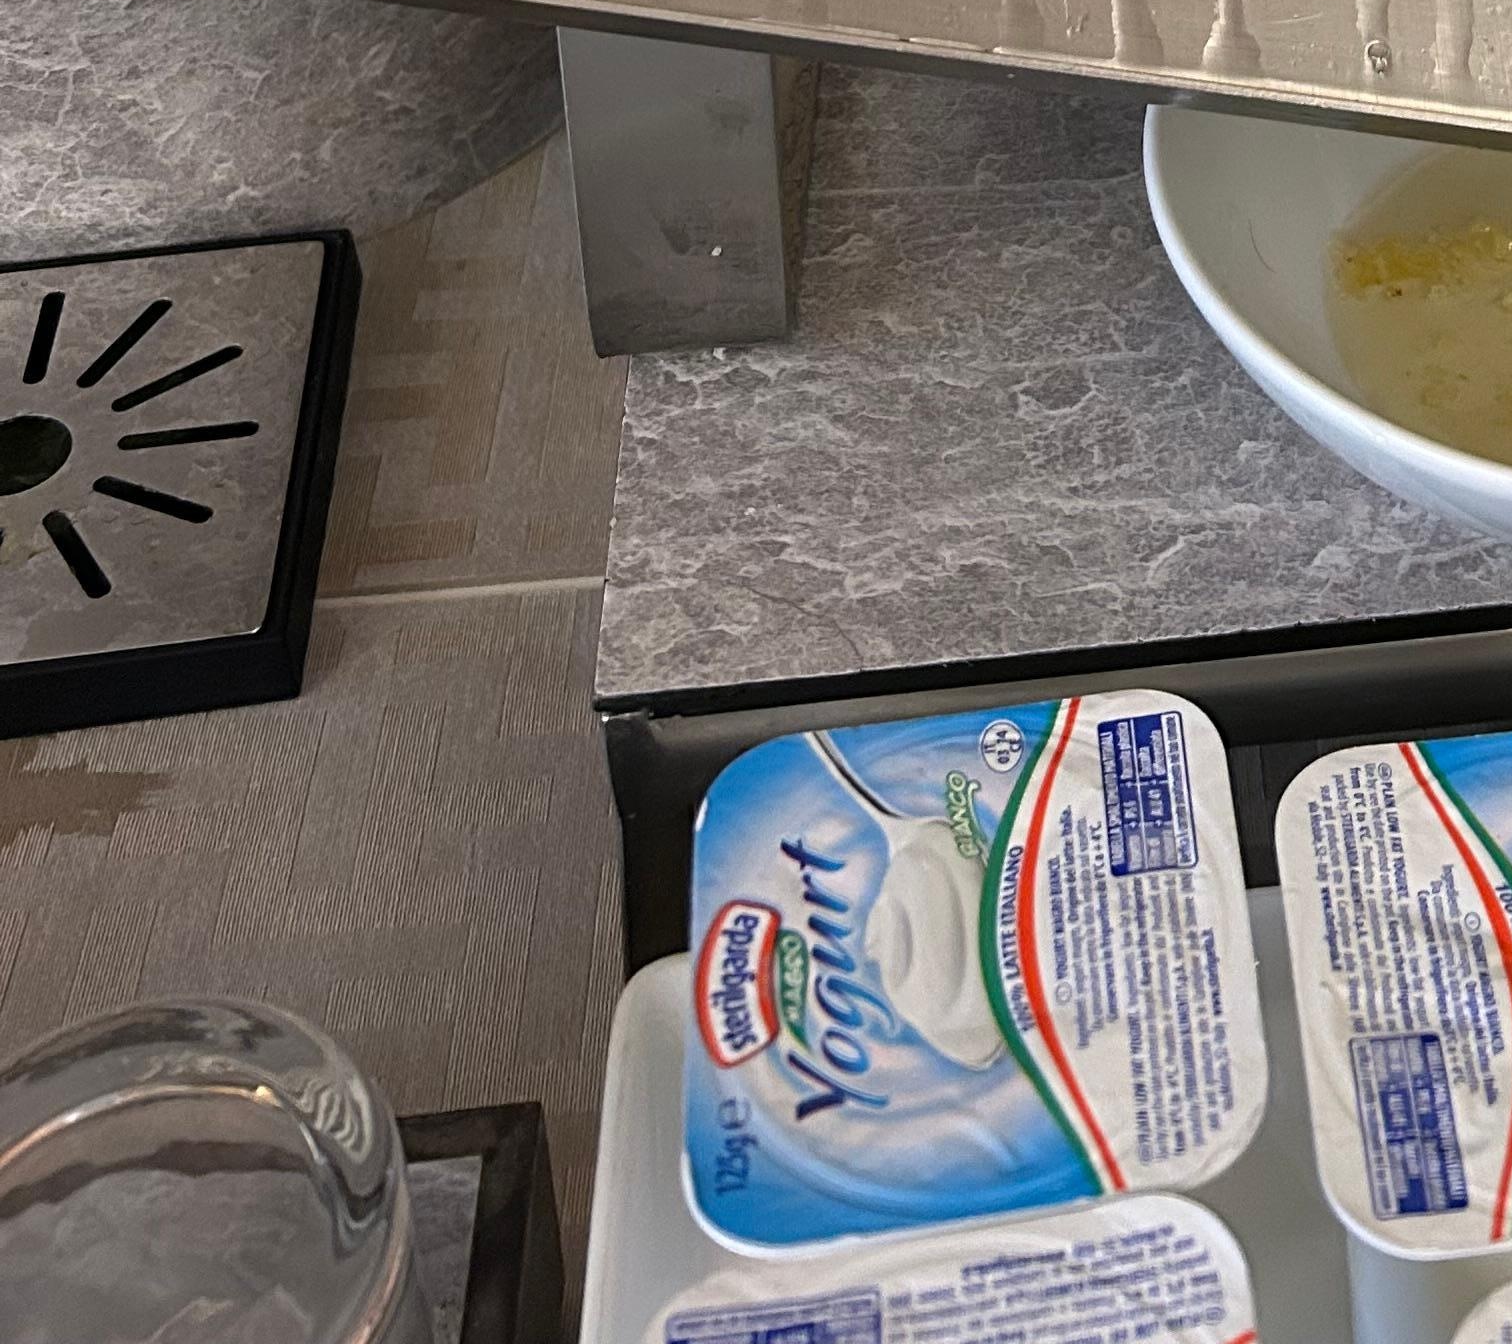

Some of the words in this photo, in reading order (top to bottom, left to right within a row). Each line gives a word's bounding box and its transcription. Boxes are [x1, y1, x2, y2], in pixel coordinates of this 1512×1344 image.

[1002, 846, 1024, 925] ITALIANO
[711, 913, 760, 1053] sterilgarda
[780, 837, 896, 1121] Yogurt
[1002, 930, 1020, 979] LATTE
